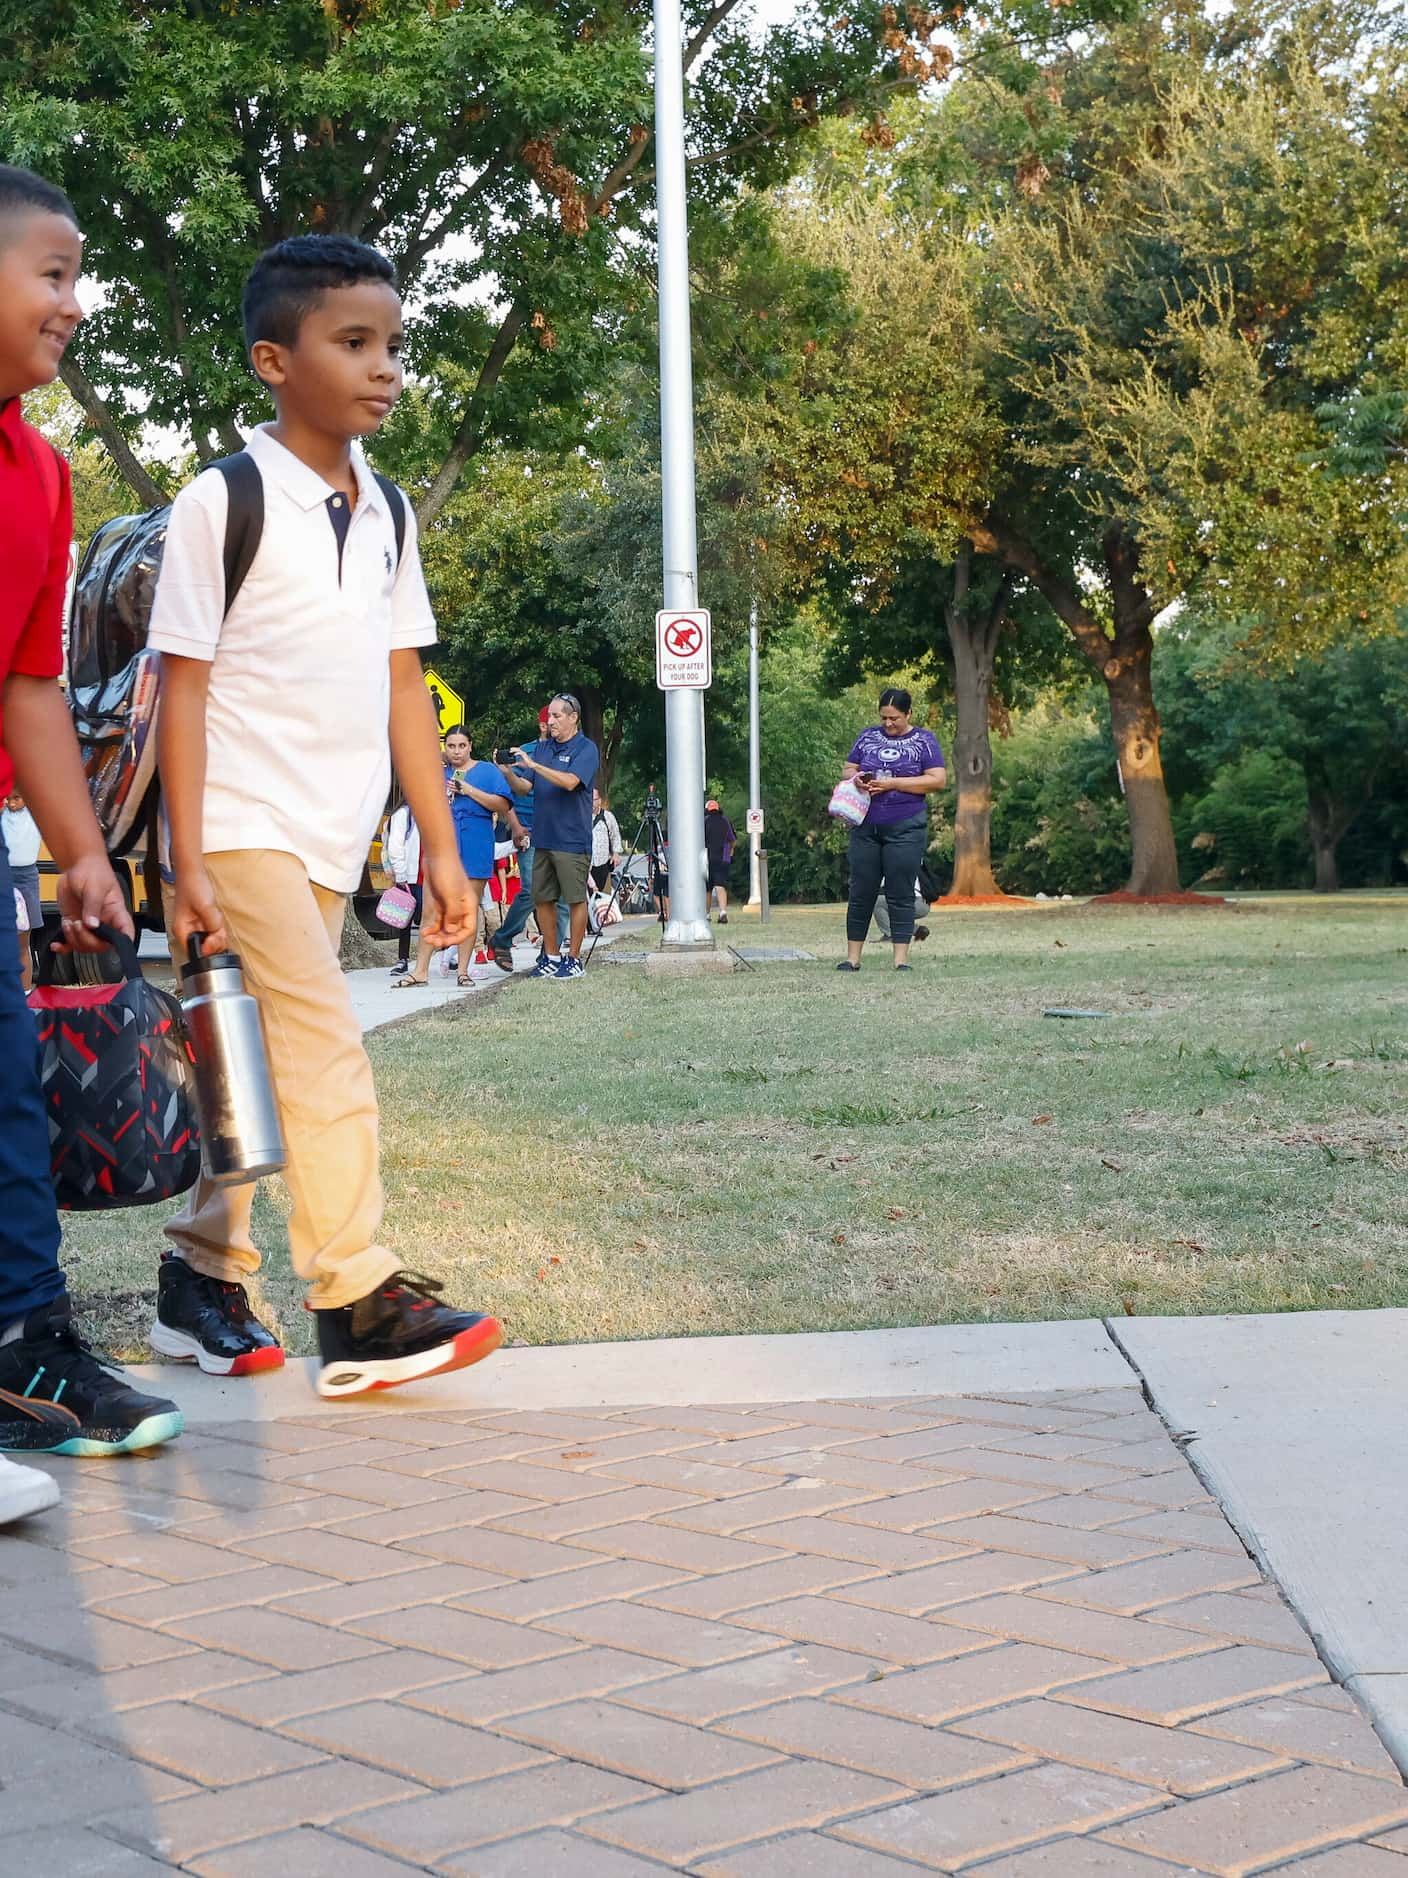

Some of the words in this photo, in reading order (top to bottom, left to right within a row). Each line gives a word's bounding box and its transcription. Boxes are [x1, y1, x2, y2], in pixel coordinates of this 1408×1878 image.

[663, 663, 676, 671] PICK
[677, 663, 686, 671] UP
[686, 662, 704, 671] AFTER
[670, 673, 685, 681] YOUR
